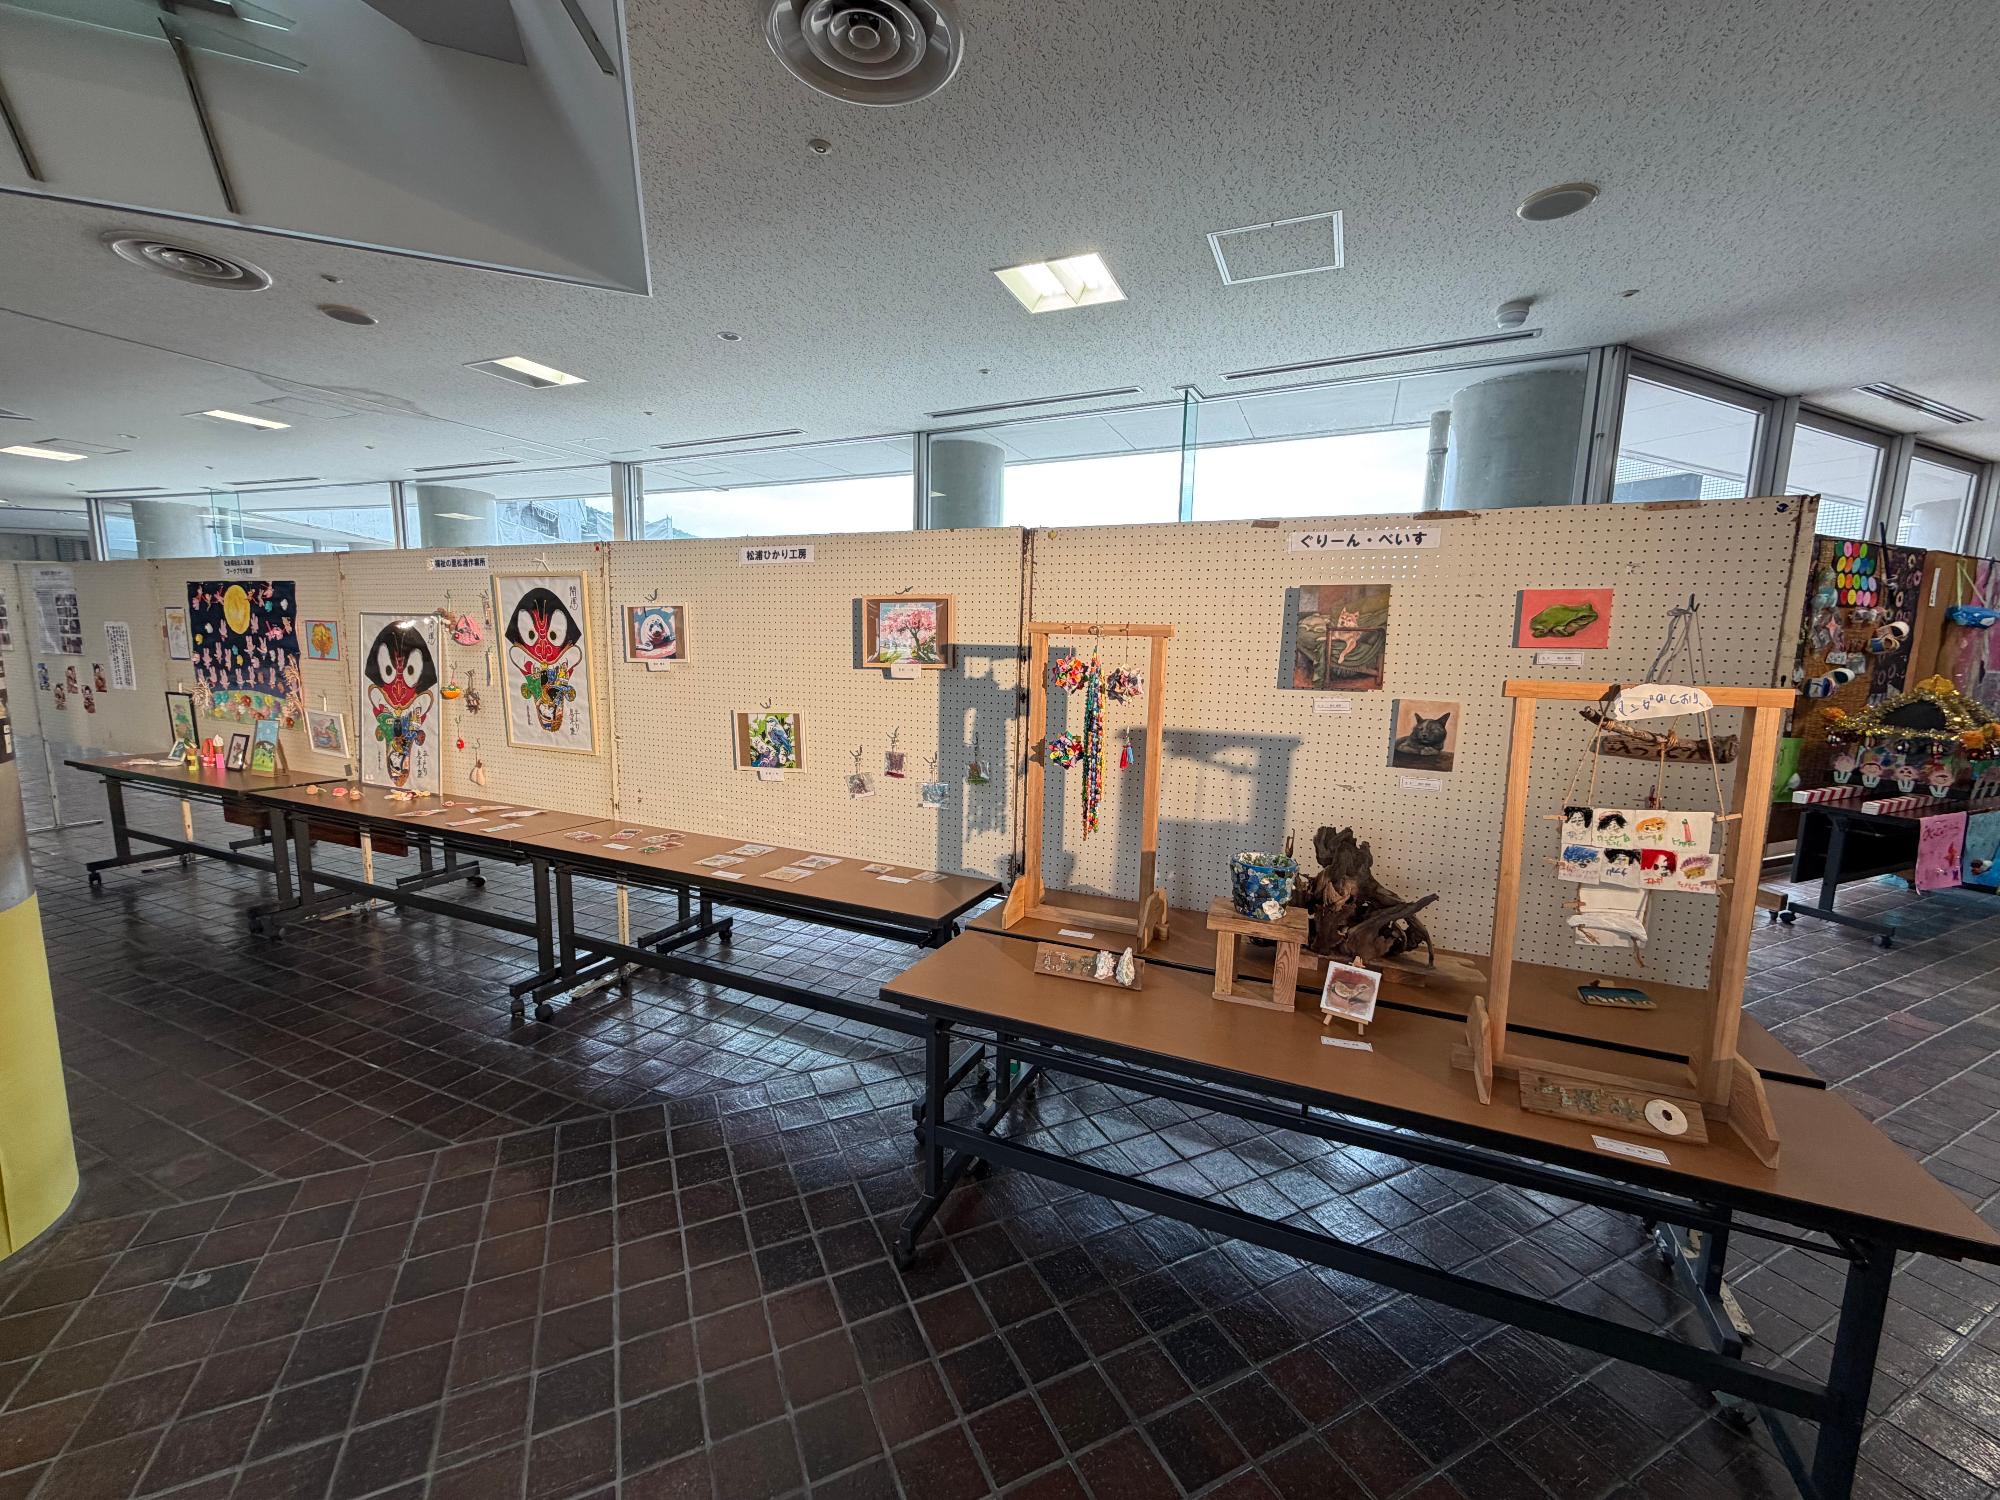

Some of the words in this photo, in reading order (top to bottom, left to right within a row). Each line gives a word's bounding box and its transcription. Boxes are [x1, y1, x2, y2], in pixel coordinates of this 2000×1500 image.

[1300, 531, 1428, 548] ぐりーん・べいす
[746, 548, 807, 561] 松浦ひかり工房
